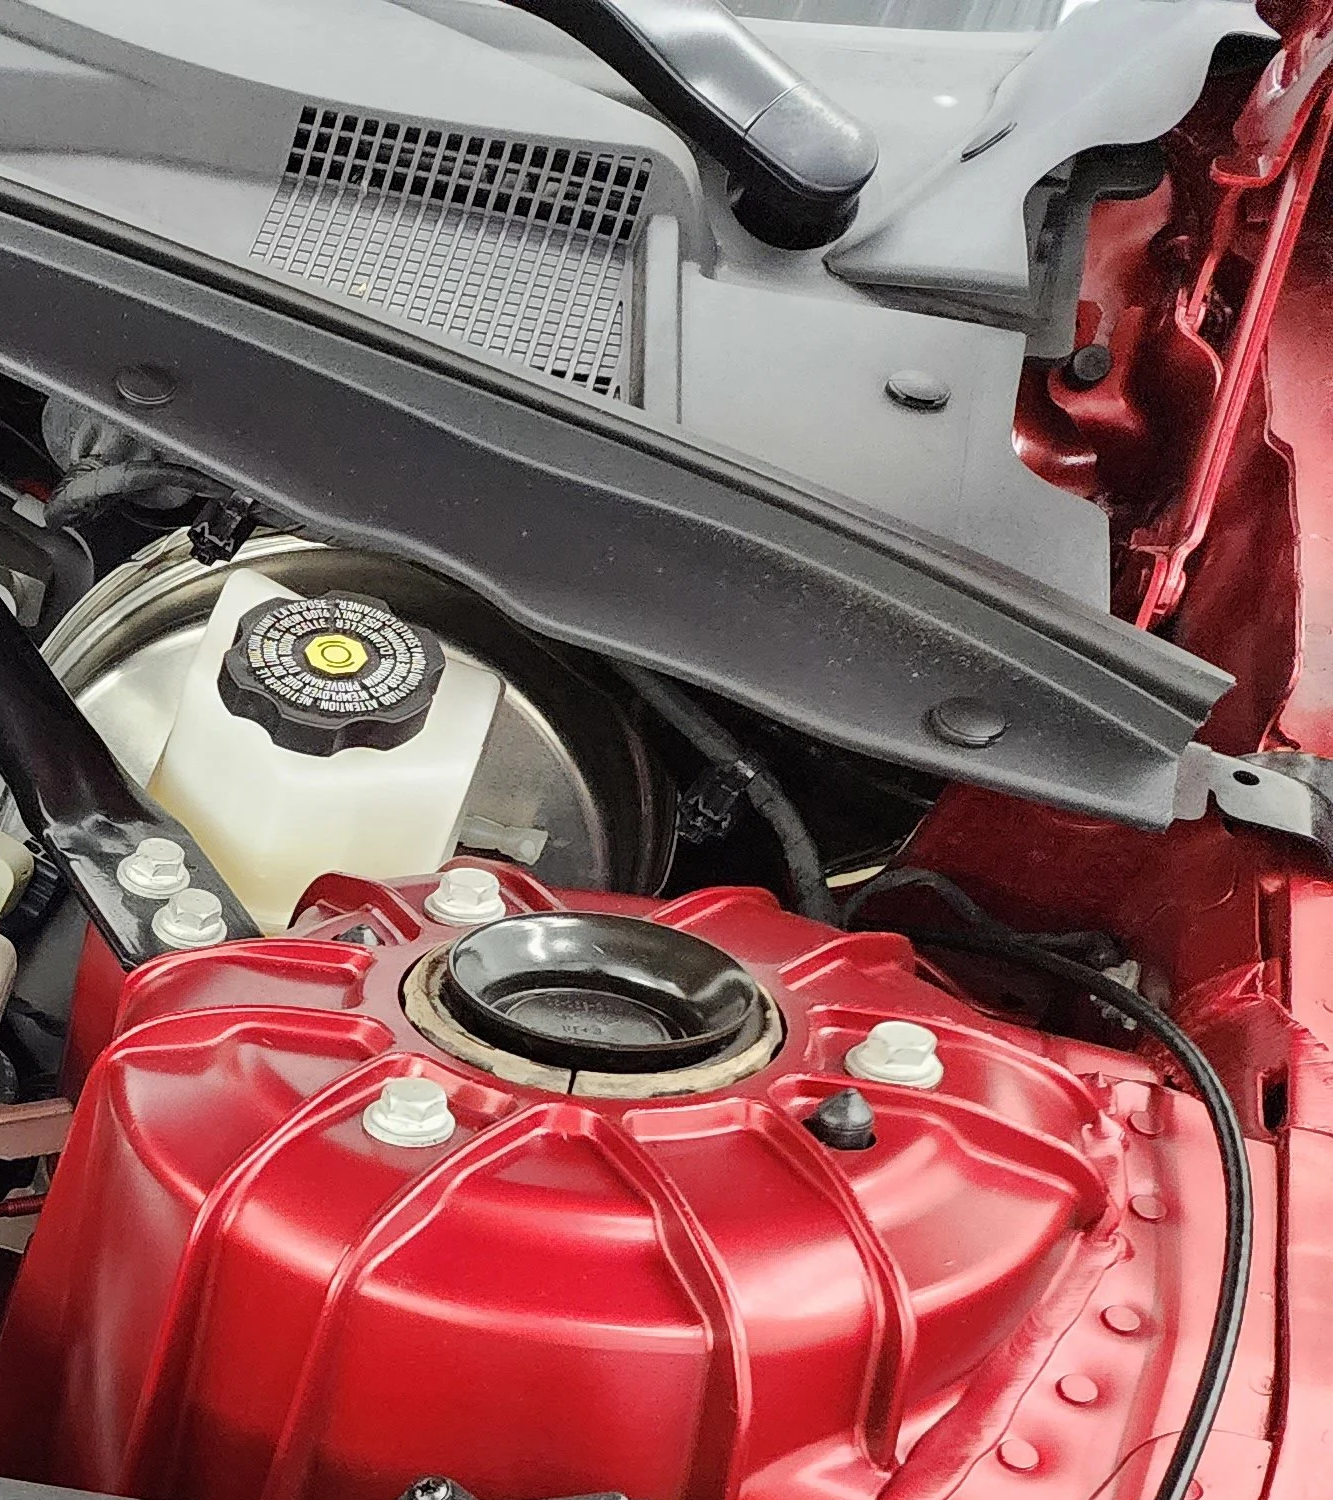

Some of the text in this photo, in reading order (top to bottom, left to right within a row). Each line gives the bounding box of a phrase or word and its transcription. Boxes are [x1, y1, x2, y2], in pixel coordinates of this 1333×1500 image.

[272, 607, 291, 618] LA
[286, 598, 328, 613] DEPOSE
[272, 613, 304, 631] FREIN
[333, 608, 362, 621] ONLY
[359, 615, 384, 629] USE
[252, 614, 278, 635] AVANT
[265, 627, 284, 639] DE
[335, 619, 374, 636] FILLER
[389, 620, 421, 647] SEALED
[366, 631, 393, 654] CLEAN
[269, 664, 288, 677] DU
[410, 652, 425, 673] FROM
[254, 667, 272, 678] LE
[294, 671, 362, 691] PROVENANT
[383, 661, 409, 688] BEFORE
[279, 674, 304, 690] QUE
[367, 682, 392, 697] CAP
[396, 672, 424, 693] FLUID
[262, 676, 313, 706] NETTOYER
